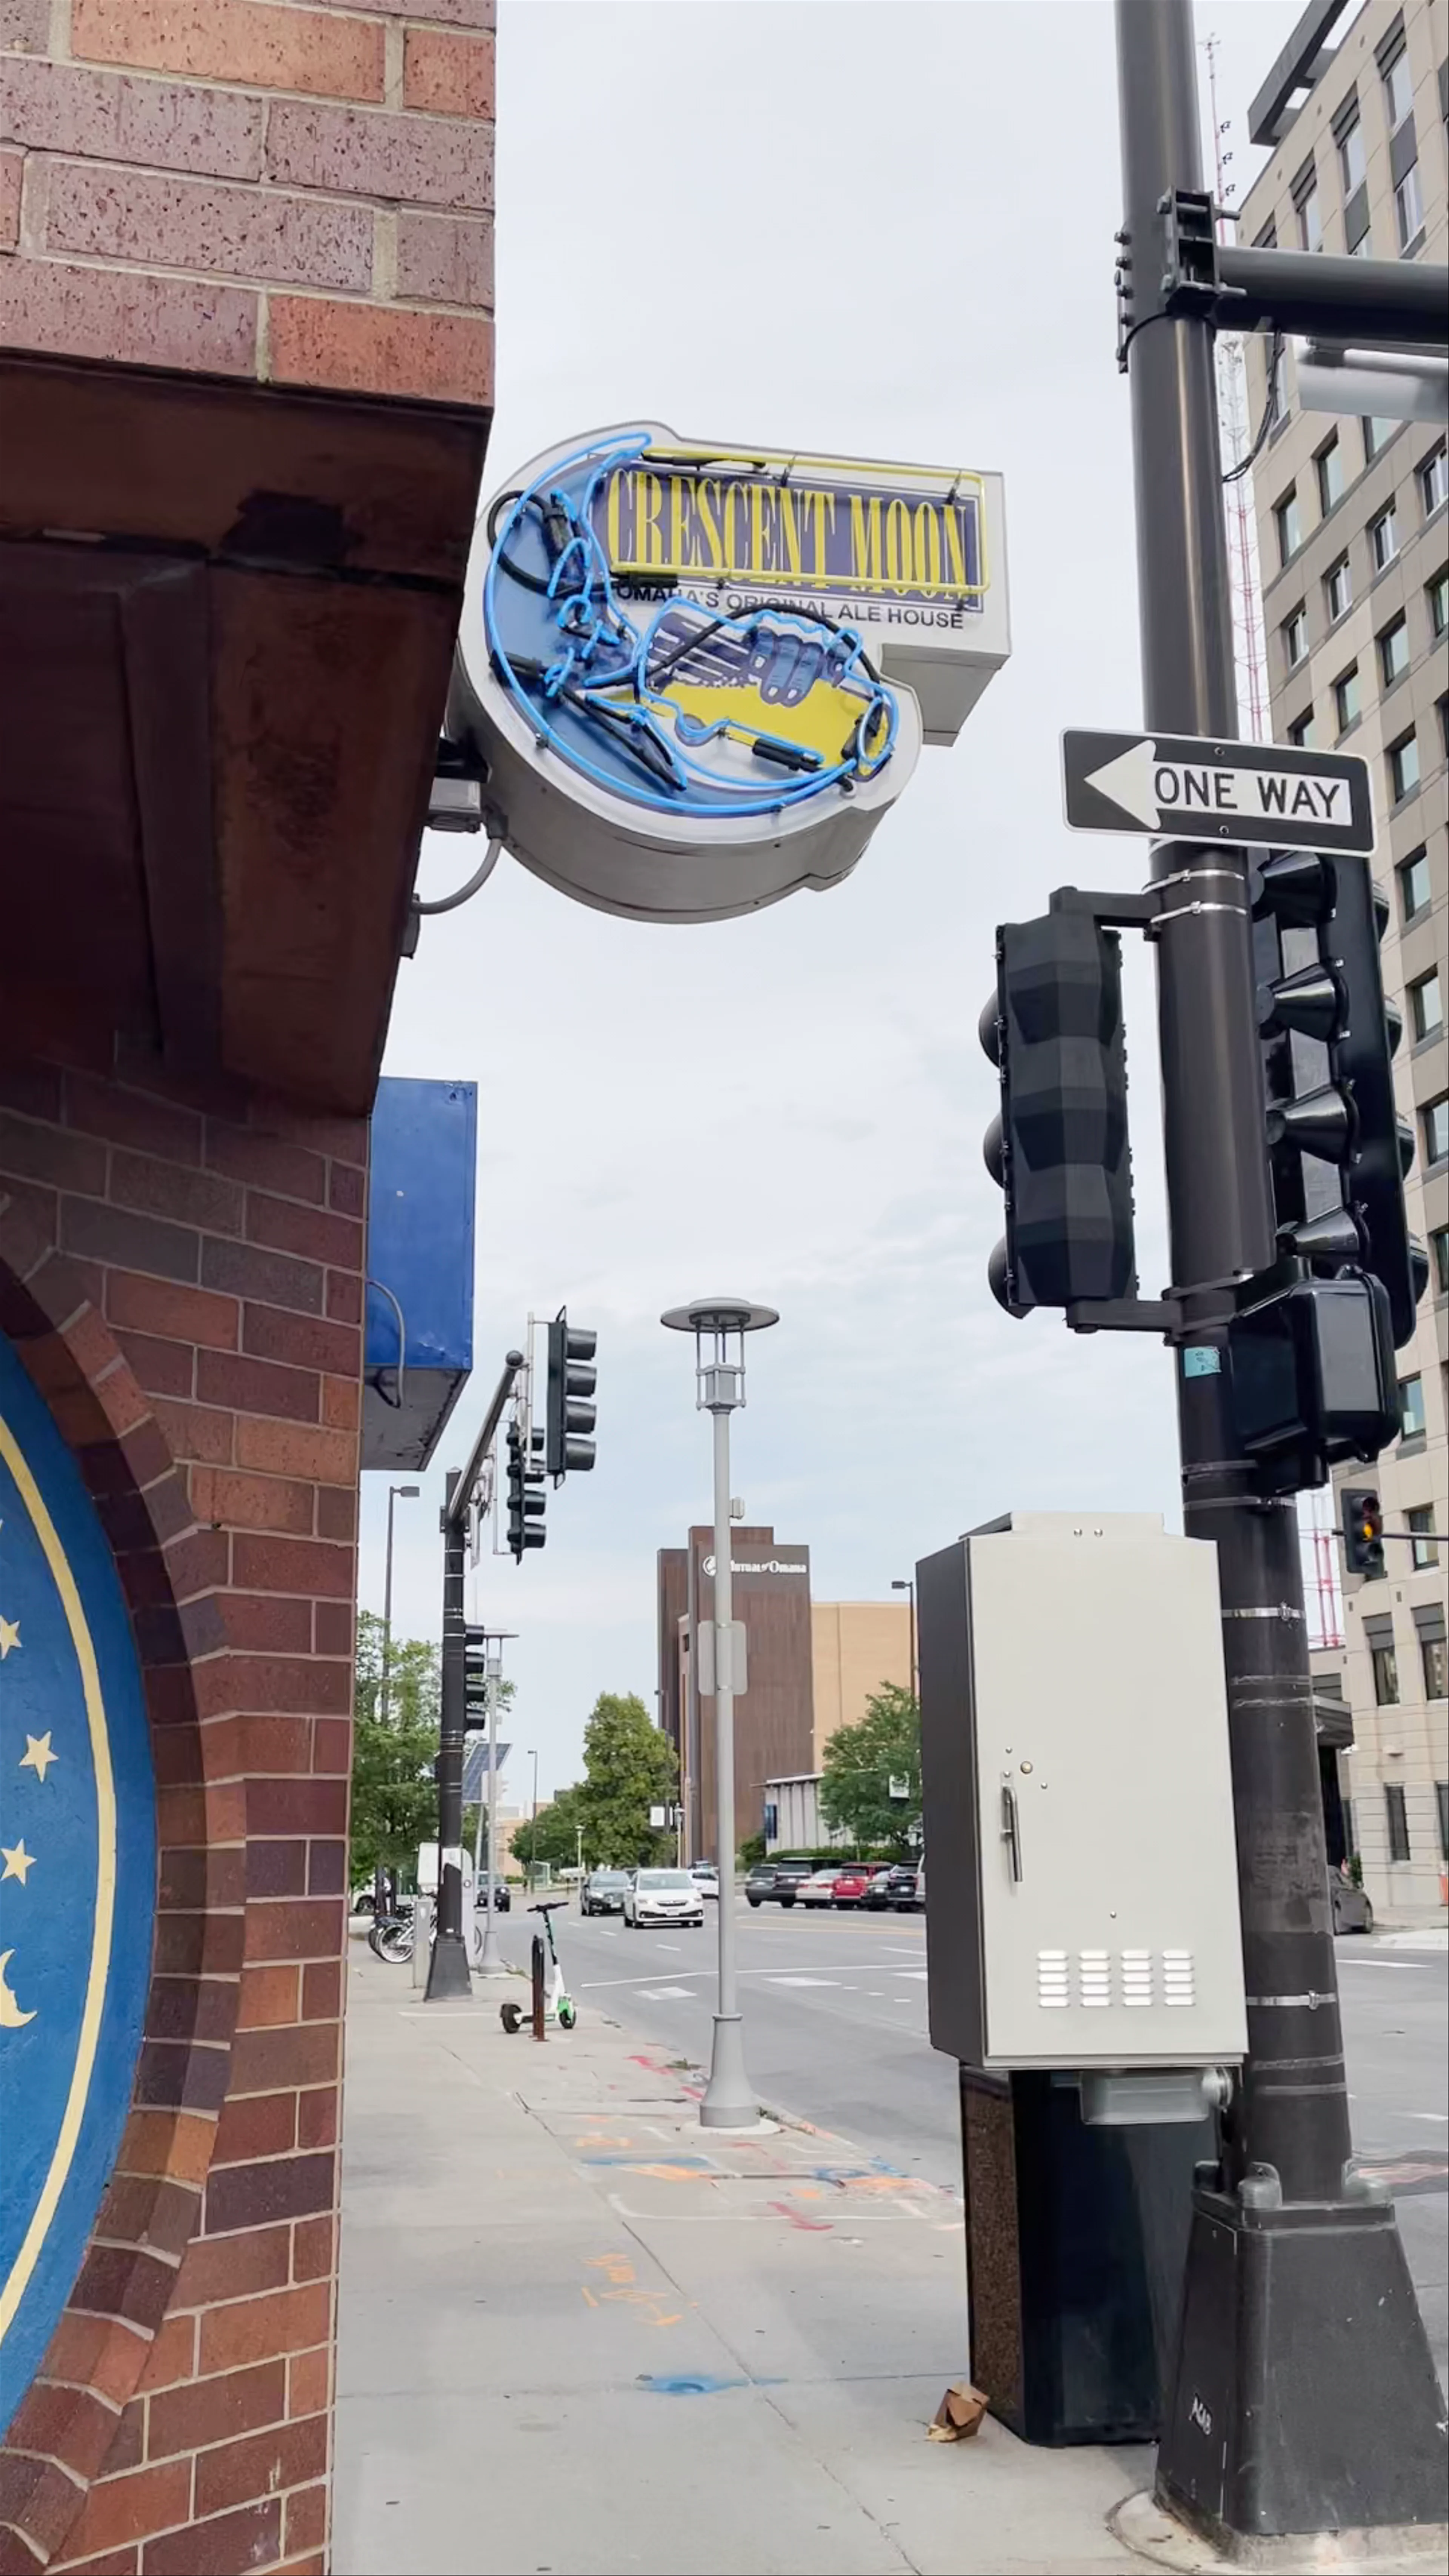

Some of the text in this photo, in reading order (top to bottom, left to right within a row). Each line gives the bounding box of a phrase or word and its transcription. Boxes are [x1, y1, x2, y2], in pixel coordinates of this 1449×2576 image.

[608, 468, 967, 600] CRESCENT MOON
[617, 585, 719, 608] OMAHA'S
[838, 604, 881, 622] ALE
[888, 608, 963, 629] HOUSE
[1155, 767, 1340, 818] ONE WAY
